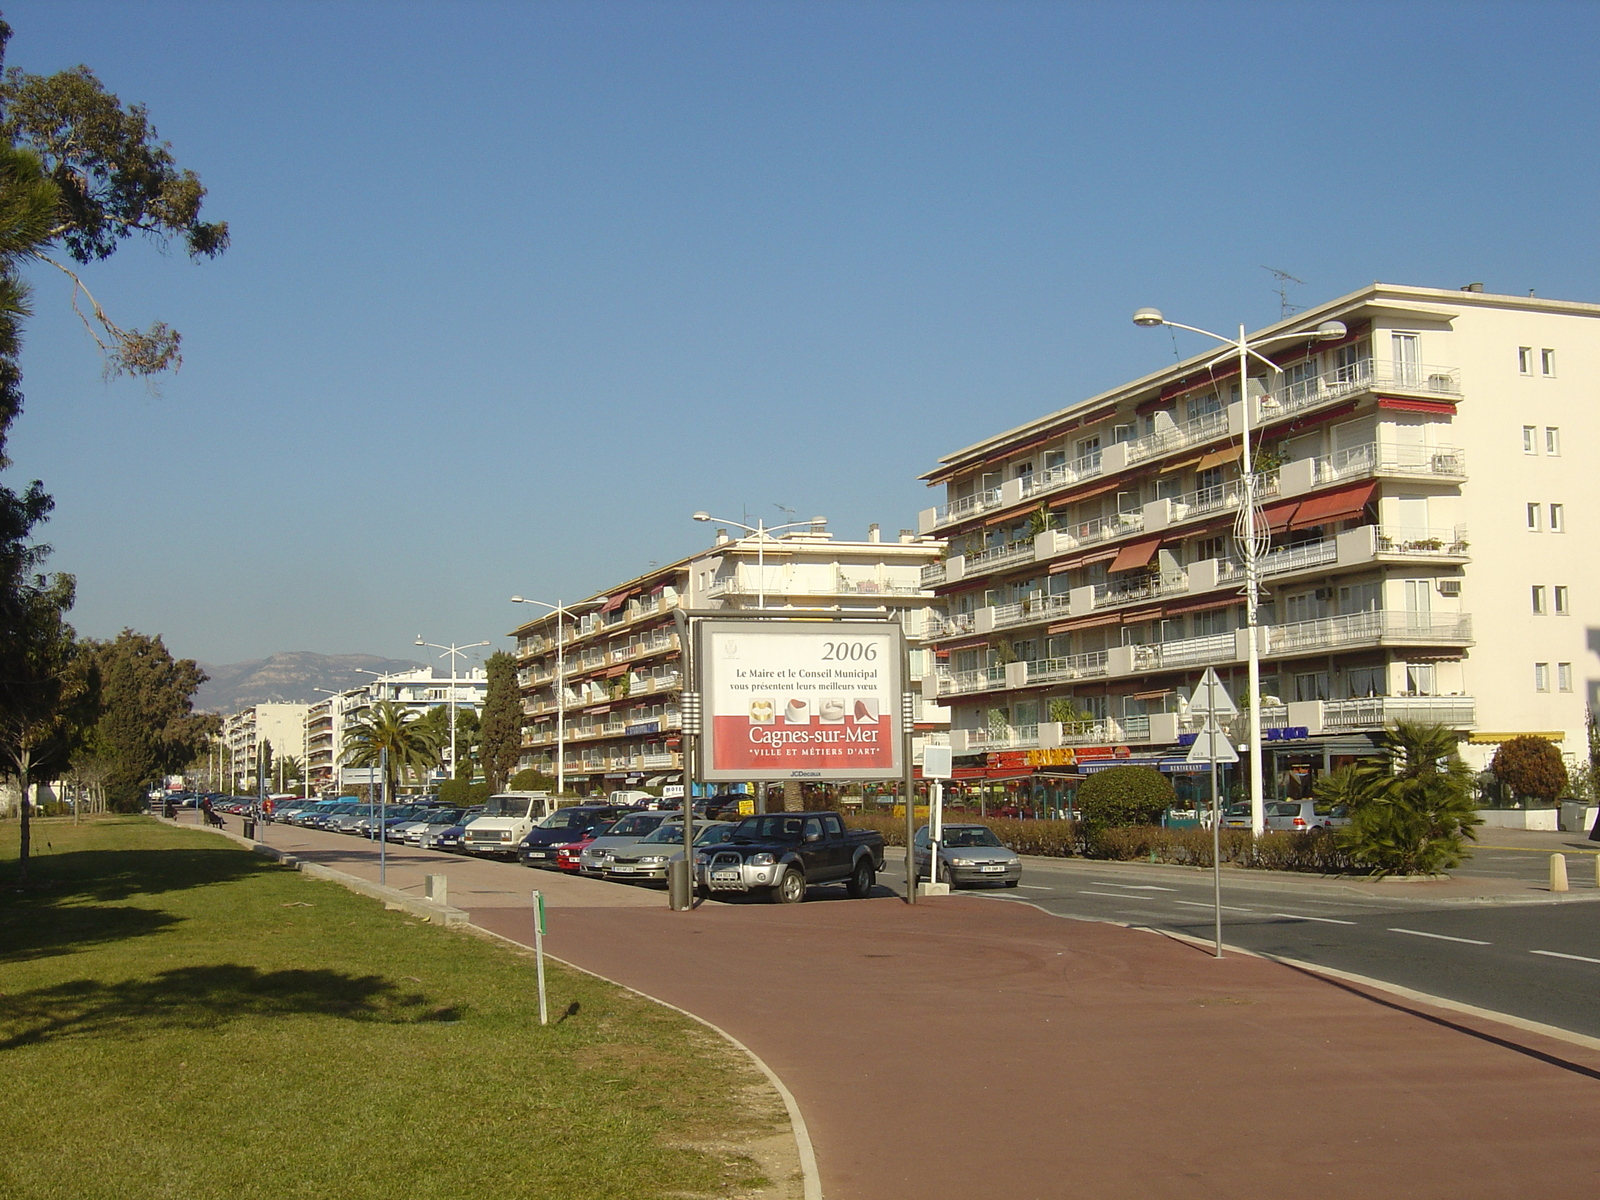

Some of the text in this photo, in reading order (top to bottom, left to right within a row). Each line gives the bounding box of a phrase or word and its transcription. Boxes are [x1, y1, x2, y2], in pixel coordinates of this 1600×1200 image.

[821, 642, 878, 661] 2006
[736, 669, 878, 680] Le Maire et le Conseil Municipal
[751, 682, 794, 692] présentent
[796, 682, 816, 690] leurs
[818, 682, 855, 690] meilleurs
[749, 726, 879, 748] Cagnes-sur-Mer
[801, 747, 843, 756] MÉTIERS
